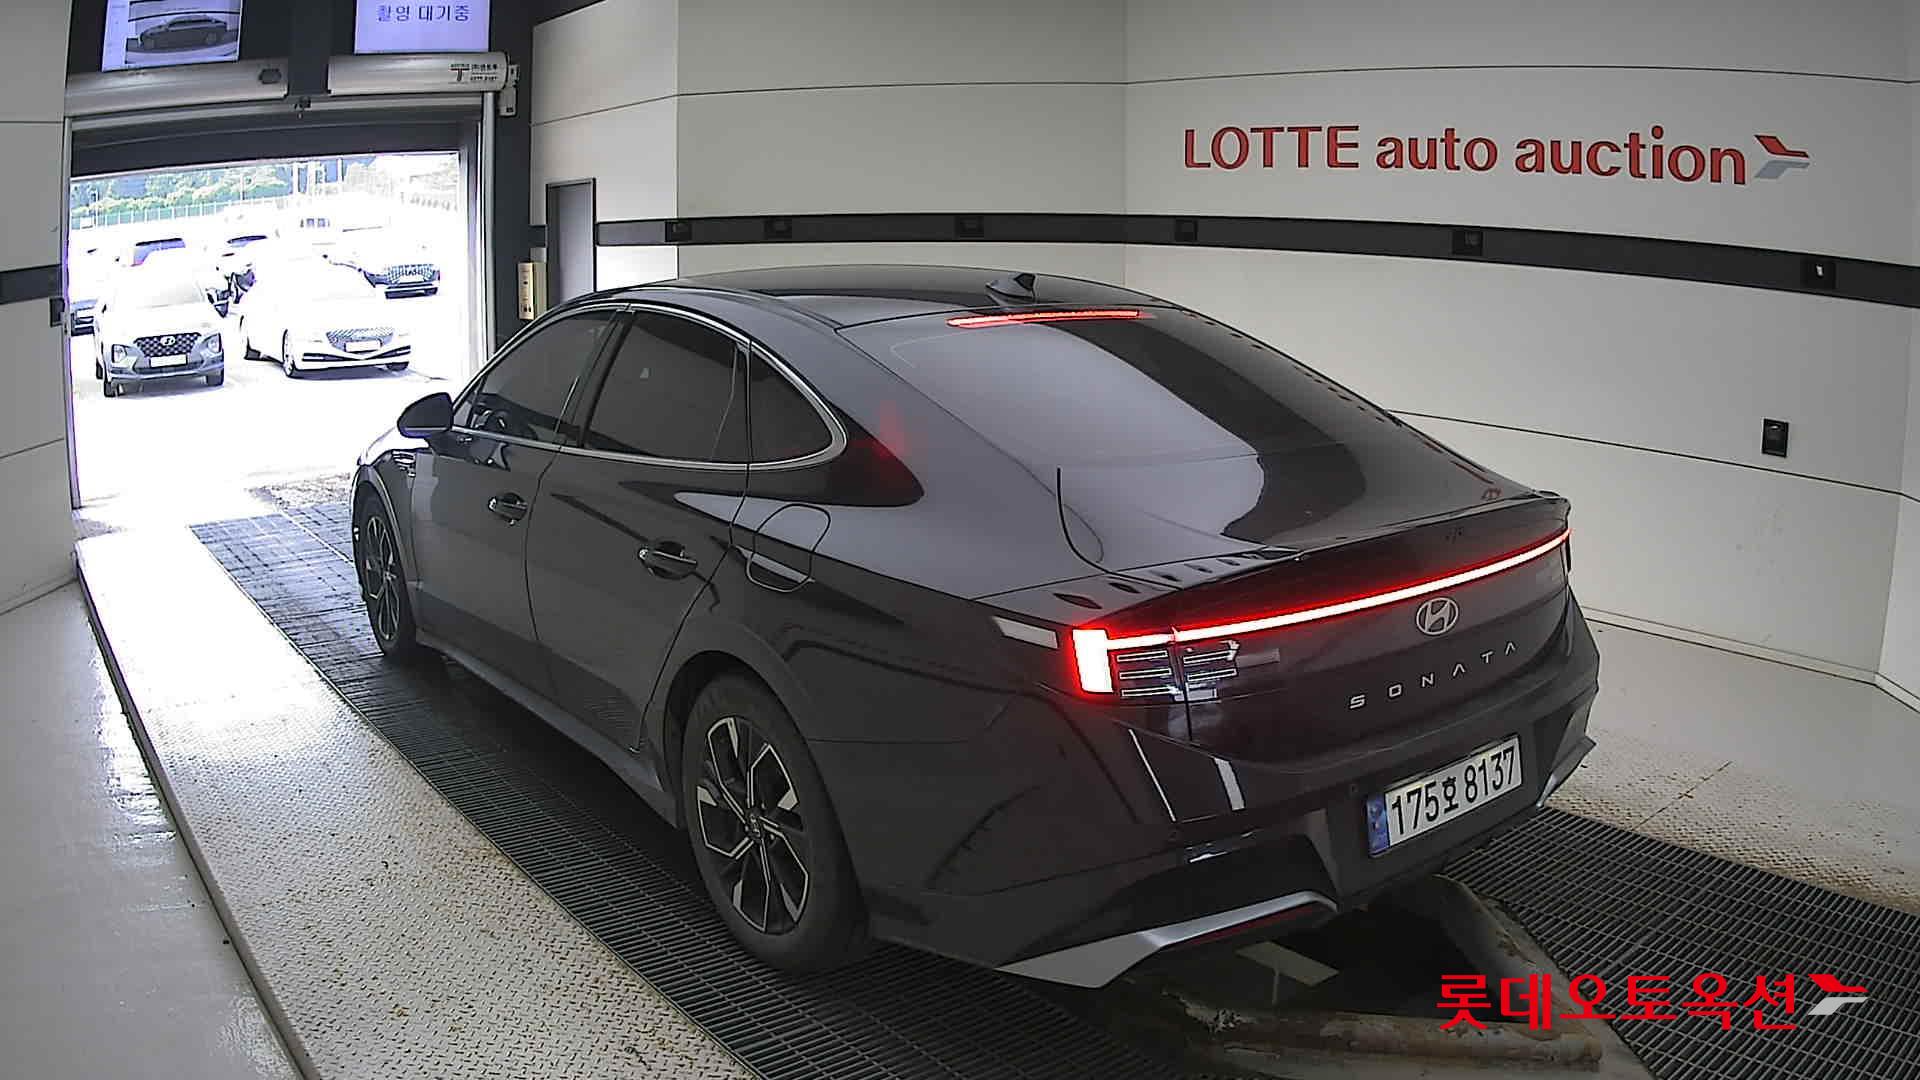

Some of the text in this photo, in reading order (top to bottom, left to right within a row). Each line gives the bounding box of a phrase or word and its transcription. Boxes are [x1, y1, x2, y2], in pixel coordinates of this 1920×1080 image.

[418, 5, 469, 21] 대기중
[1185, 127, 1745, 183] LOTTE auto auction
[1349, 641, 1516, 709] SONATA
[1464, 746, 1515, 803] 8137
